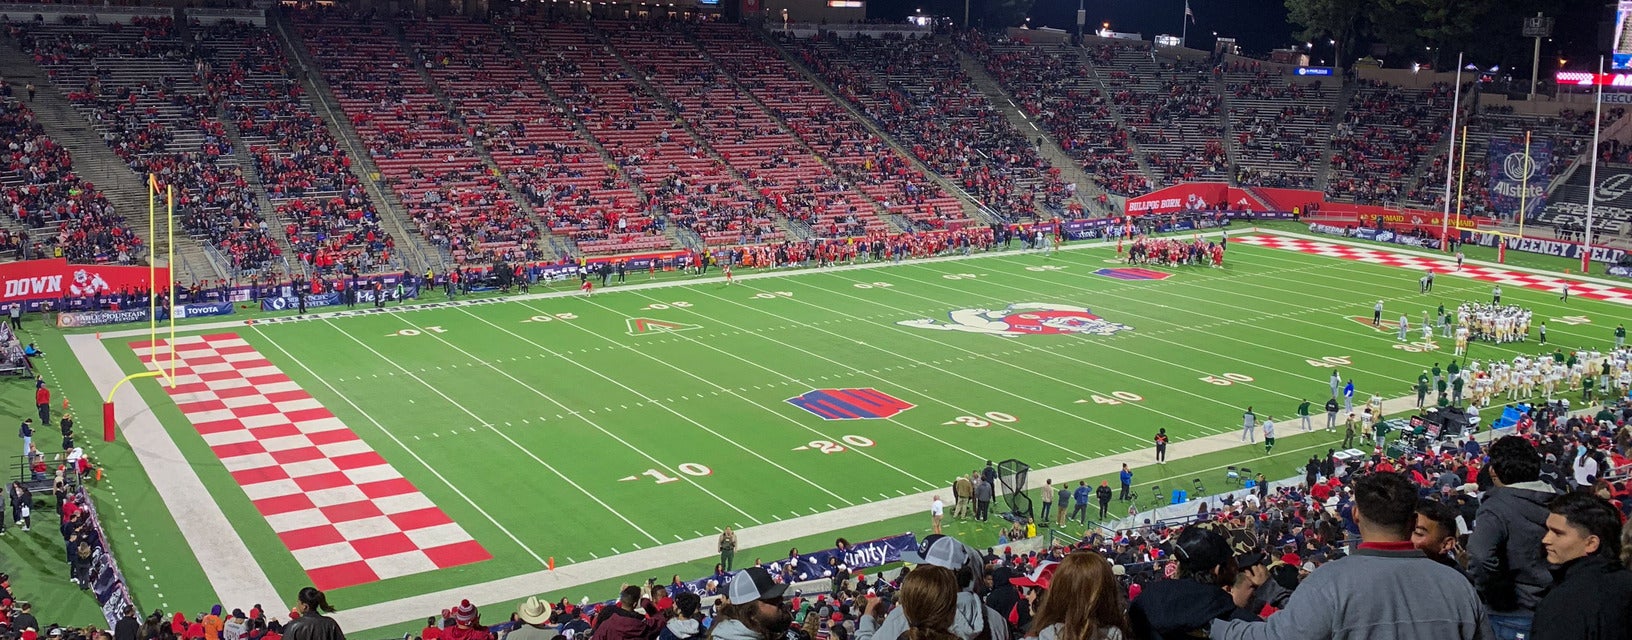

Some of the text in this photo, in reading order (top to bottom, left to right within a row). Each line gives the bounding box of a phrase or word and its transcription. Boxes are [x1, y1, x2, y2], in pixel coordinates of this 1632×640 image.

[1493, 181, 1544, 197] Allstate
[1128, 199, 1181, 211] BULLDOG BORN
[1574, 244, 1625, 263] FELD
[4, 275, 62, 297] DOWN
[102, 310, 146, 319] MOUNTAIN
[187, 306, 219, 314] TOYOTA
[1199, 372, 1254, 386] 50
[1091, 391, 1145, 405] 40
[955, 410, 1020, 429] 30
[808, 434, 878, 455] 20
[641, 462, 714, 484] 10
[844, 542, 888, 566] inity
